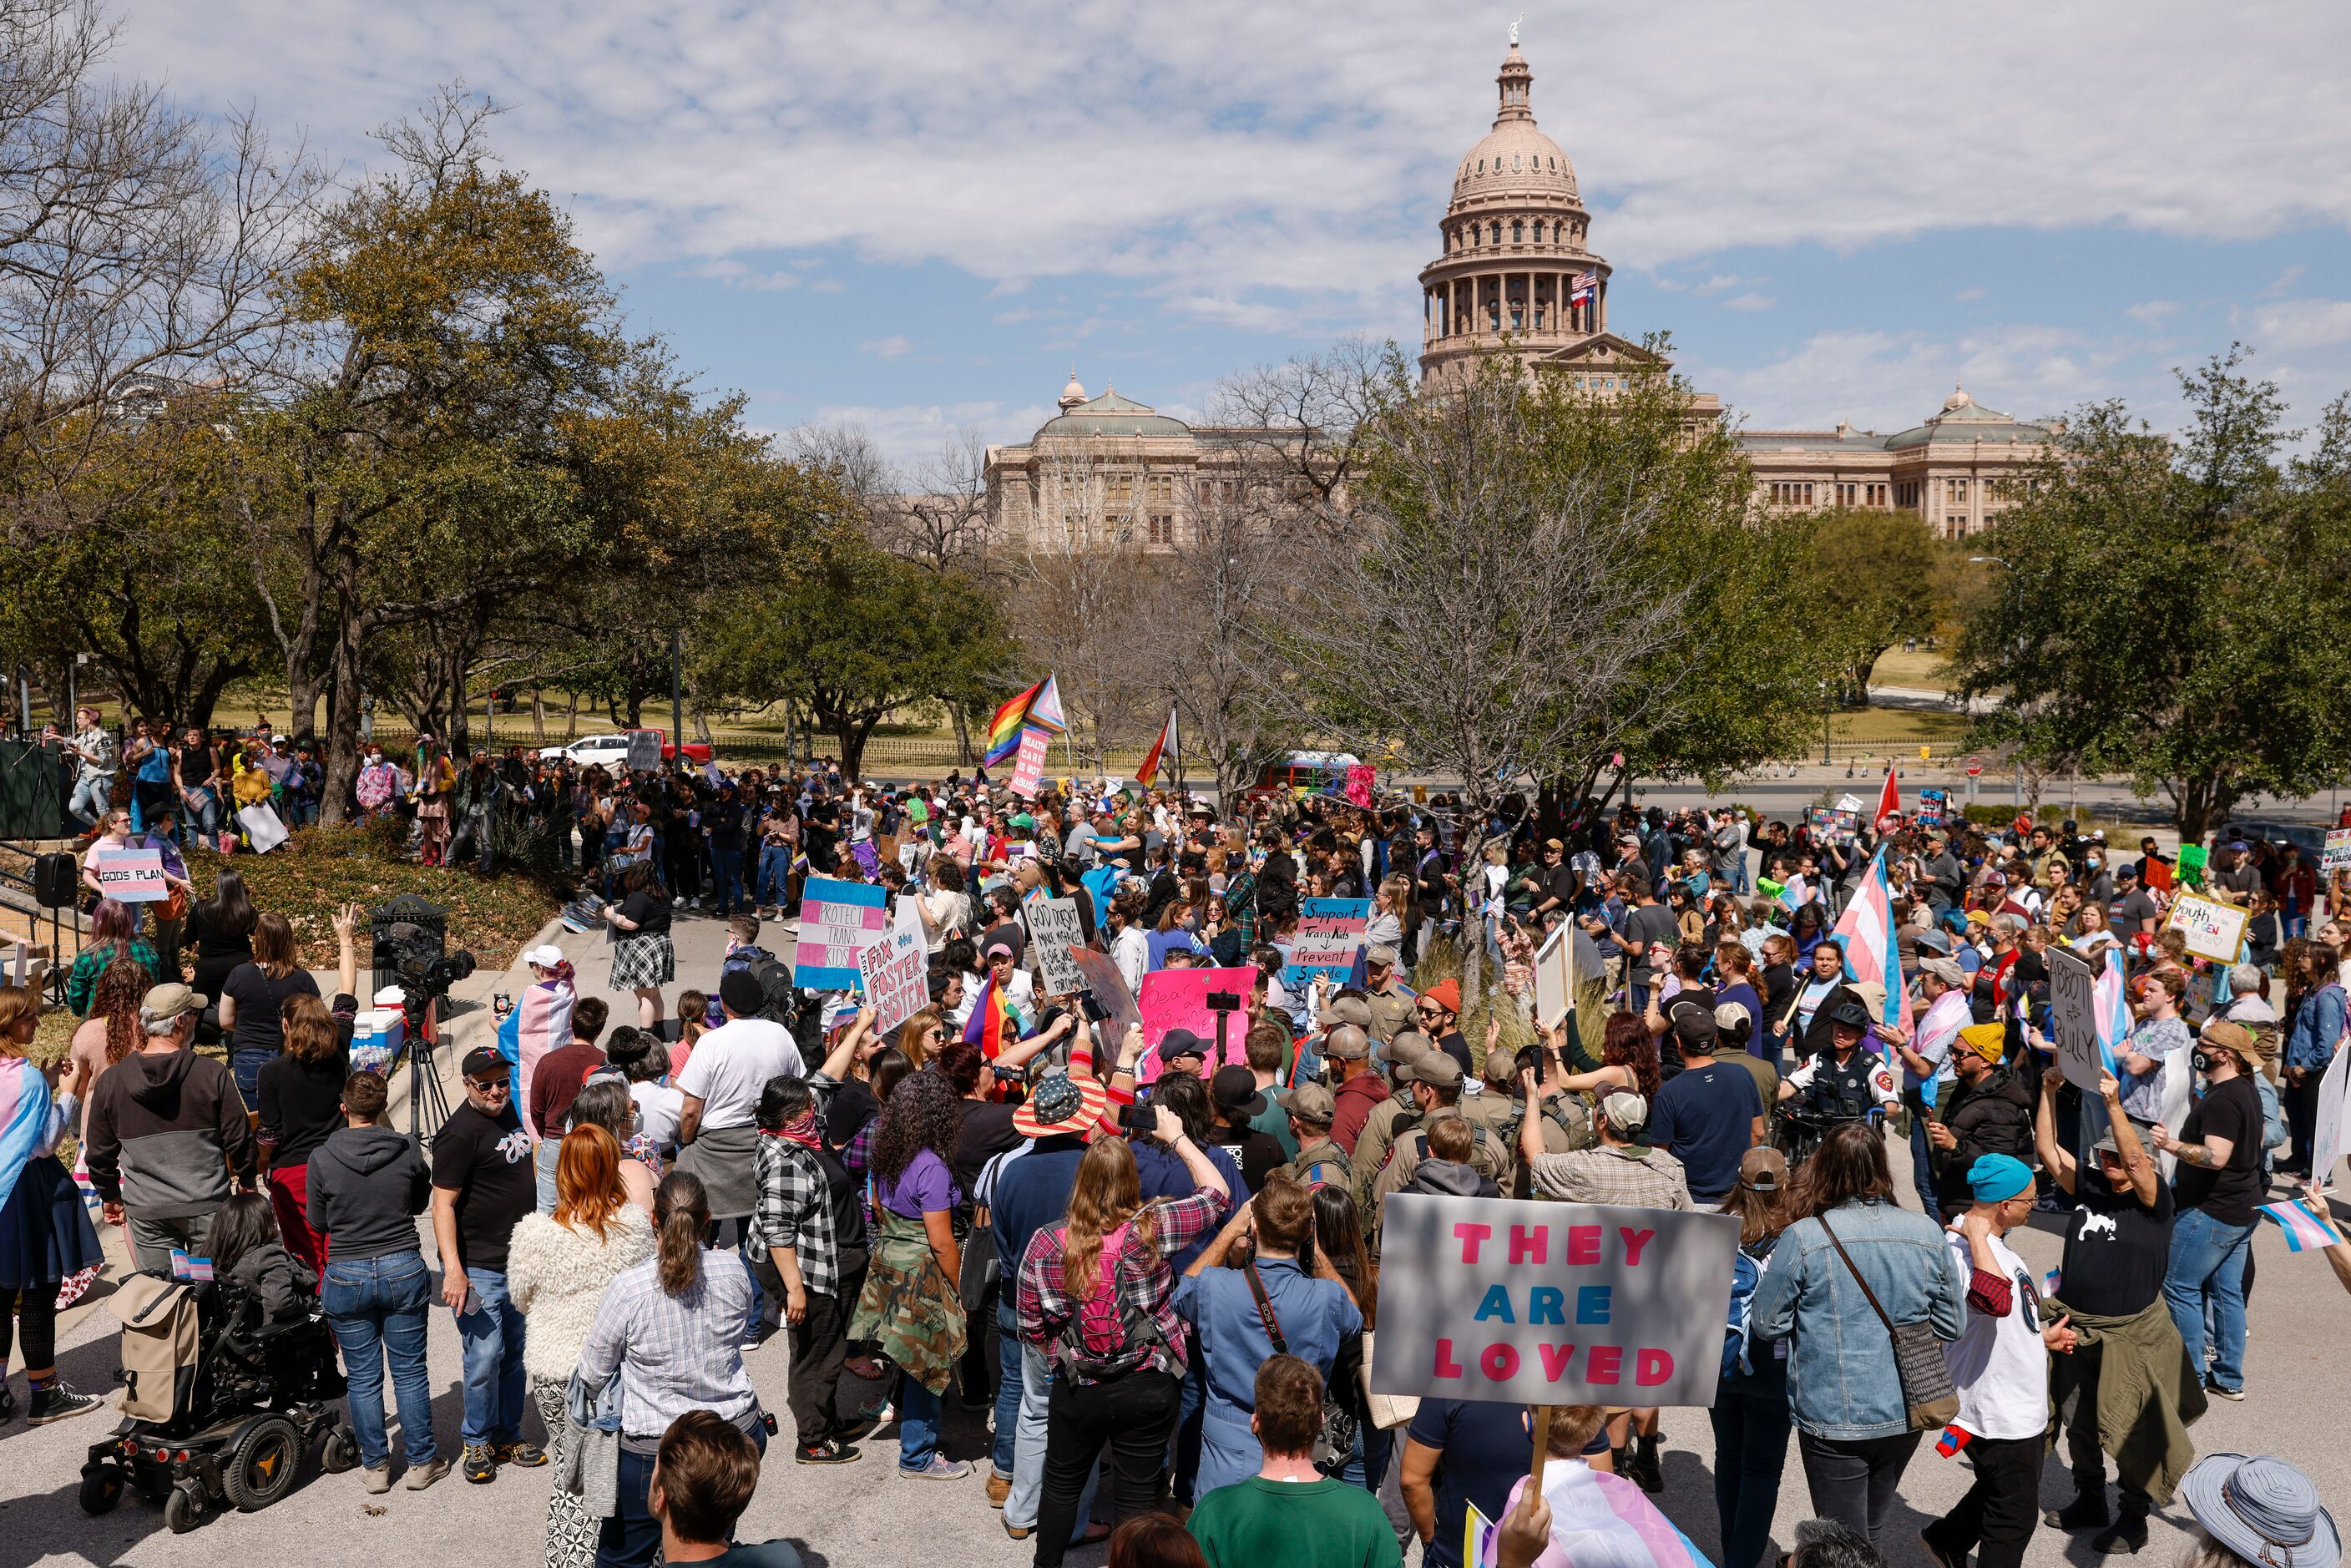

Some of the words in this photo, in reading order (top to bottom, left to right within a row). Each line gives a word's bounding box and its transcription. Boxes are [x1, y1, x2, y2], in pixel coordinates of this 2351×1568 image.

[1023, 735, 1045, 752] HEALTH
[1021, 749, 1042, 765] CARE
[1019, 761, 1025, 772] IS
[1027, 764, 1040, 776] NOT
[1813, 814, 1833, 822] HOME
[135, 869, 164, 880] PLAN
[819, 903, 863, 925] PROTECT
[1028, 903, 1051, 929] GOD
[1306, 903, 1360, 924] Support
[828, 926, 856, 944] TRANS
[1304, 925, 1331, 938] Trans
[1331, 926, 1349, 939] Kids
[2174, 914, 2198, 928] NEXT
[2202, 923, 2220, 935] GEN
[897, 933, 913, 948] the
[1037, 932, 1056, 948] MAKE
[826, 947, 848, 968] KIDS
[1297, 947, 1347, 963] Prevent
[869, 950, 922, 1004] FOSTER
[1054, 978, 1065, 993] FOR
[2049, 957, 2091, 1015] ABBOTT
[872, 977, 927, 1035] SYSTEM
[1148, 984, 1191, 1008] Dear
[2054, 1015, 2095, 1070] BULLY
[1454, 1222, 1656, 1267] THEY
[1473, 1284, 1611, 1325] ARE
[1261, 1302, 1272, 1322] EOS
[1269, 1323, 1277, 1333] 7D
[1433, 1338, 1675, 1386] LOVED
